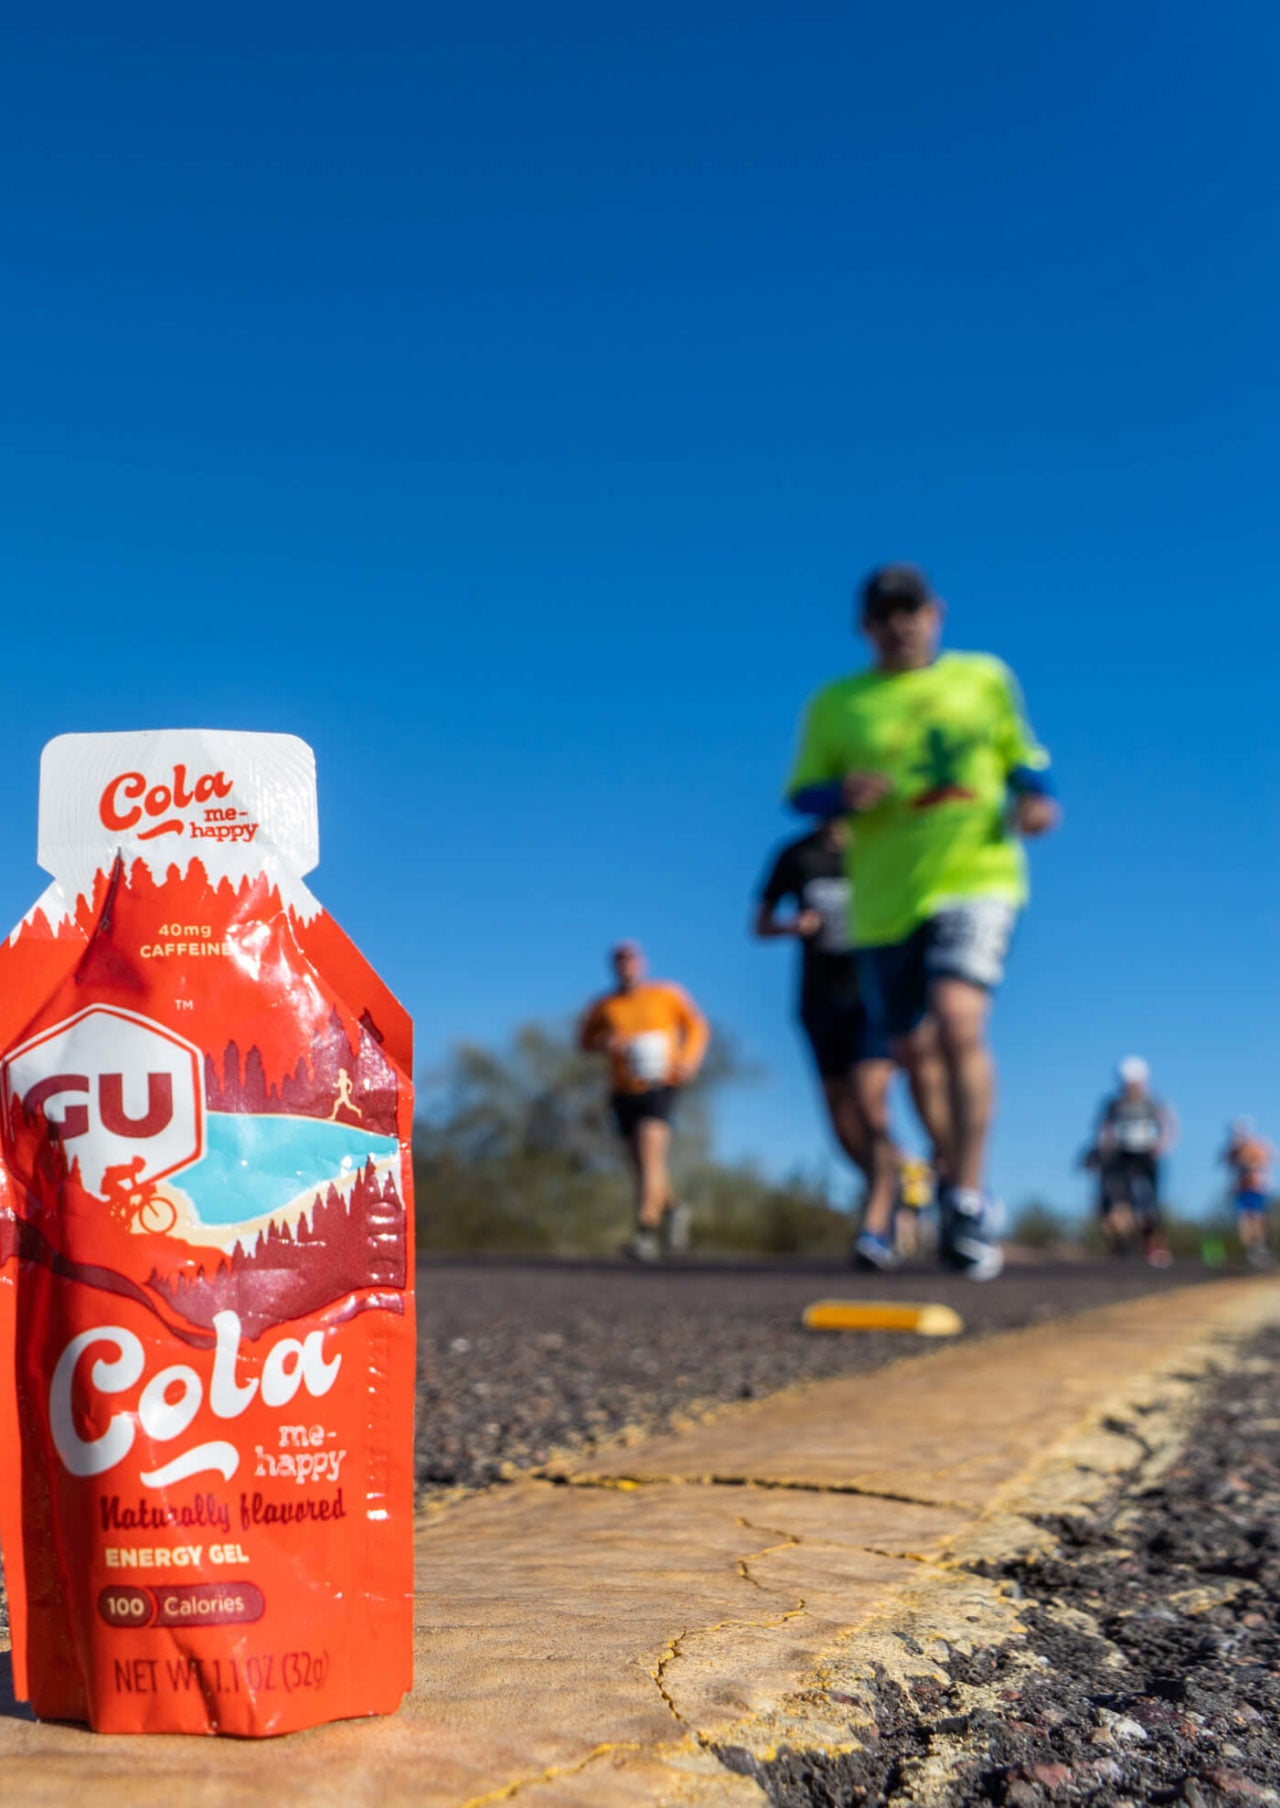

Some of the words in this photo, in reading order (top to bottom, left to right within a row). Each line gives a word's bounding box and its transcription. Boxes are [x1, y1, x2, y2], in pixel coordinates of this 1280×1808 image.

[99, 764, 234, 832] Cola
[204, 807, 248, 822] me-
[190, 821, 259, 843] happy
[159, 923, 211, 938] 40mg
[140, 942, 234, 958] CAFFEINE
[175, 999, 193, 1010] TM
[22, 1072, 173, 1140] GU
[49, 1310, 342, 1477] Cola
[279, 1423, 337, 1447] me-
[255, 1446, 347, 1484] happy
[100, 1492, 231, 1533] Naturally
[240, 1488, 347, 1530] flavored
[105, 1544, 202, 1568] ENERGY
[209, 1544, 249, 1564] GEL
[107, 1597, 144, 1616] 100
[164, 1595, 244, 1616] Calories
[114, 1658, 158, 1693] NET
[246, 1654, 277, 1690] OZ
[282, 1650, 329, 1694] (32g)
